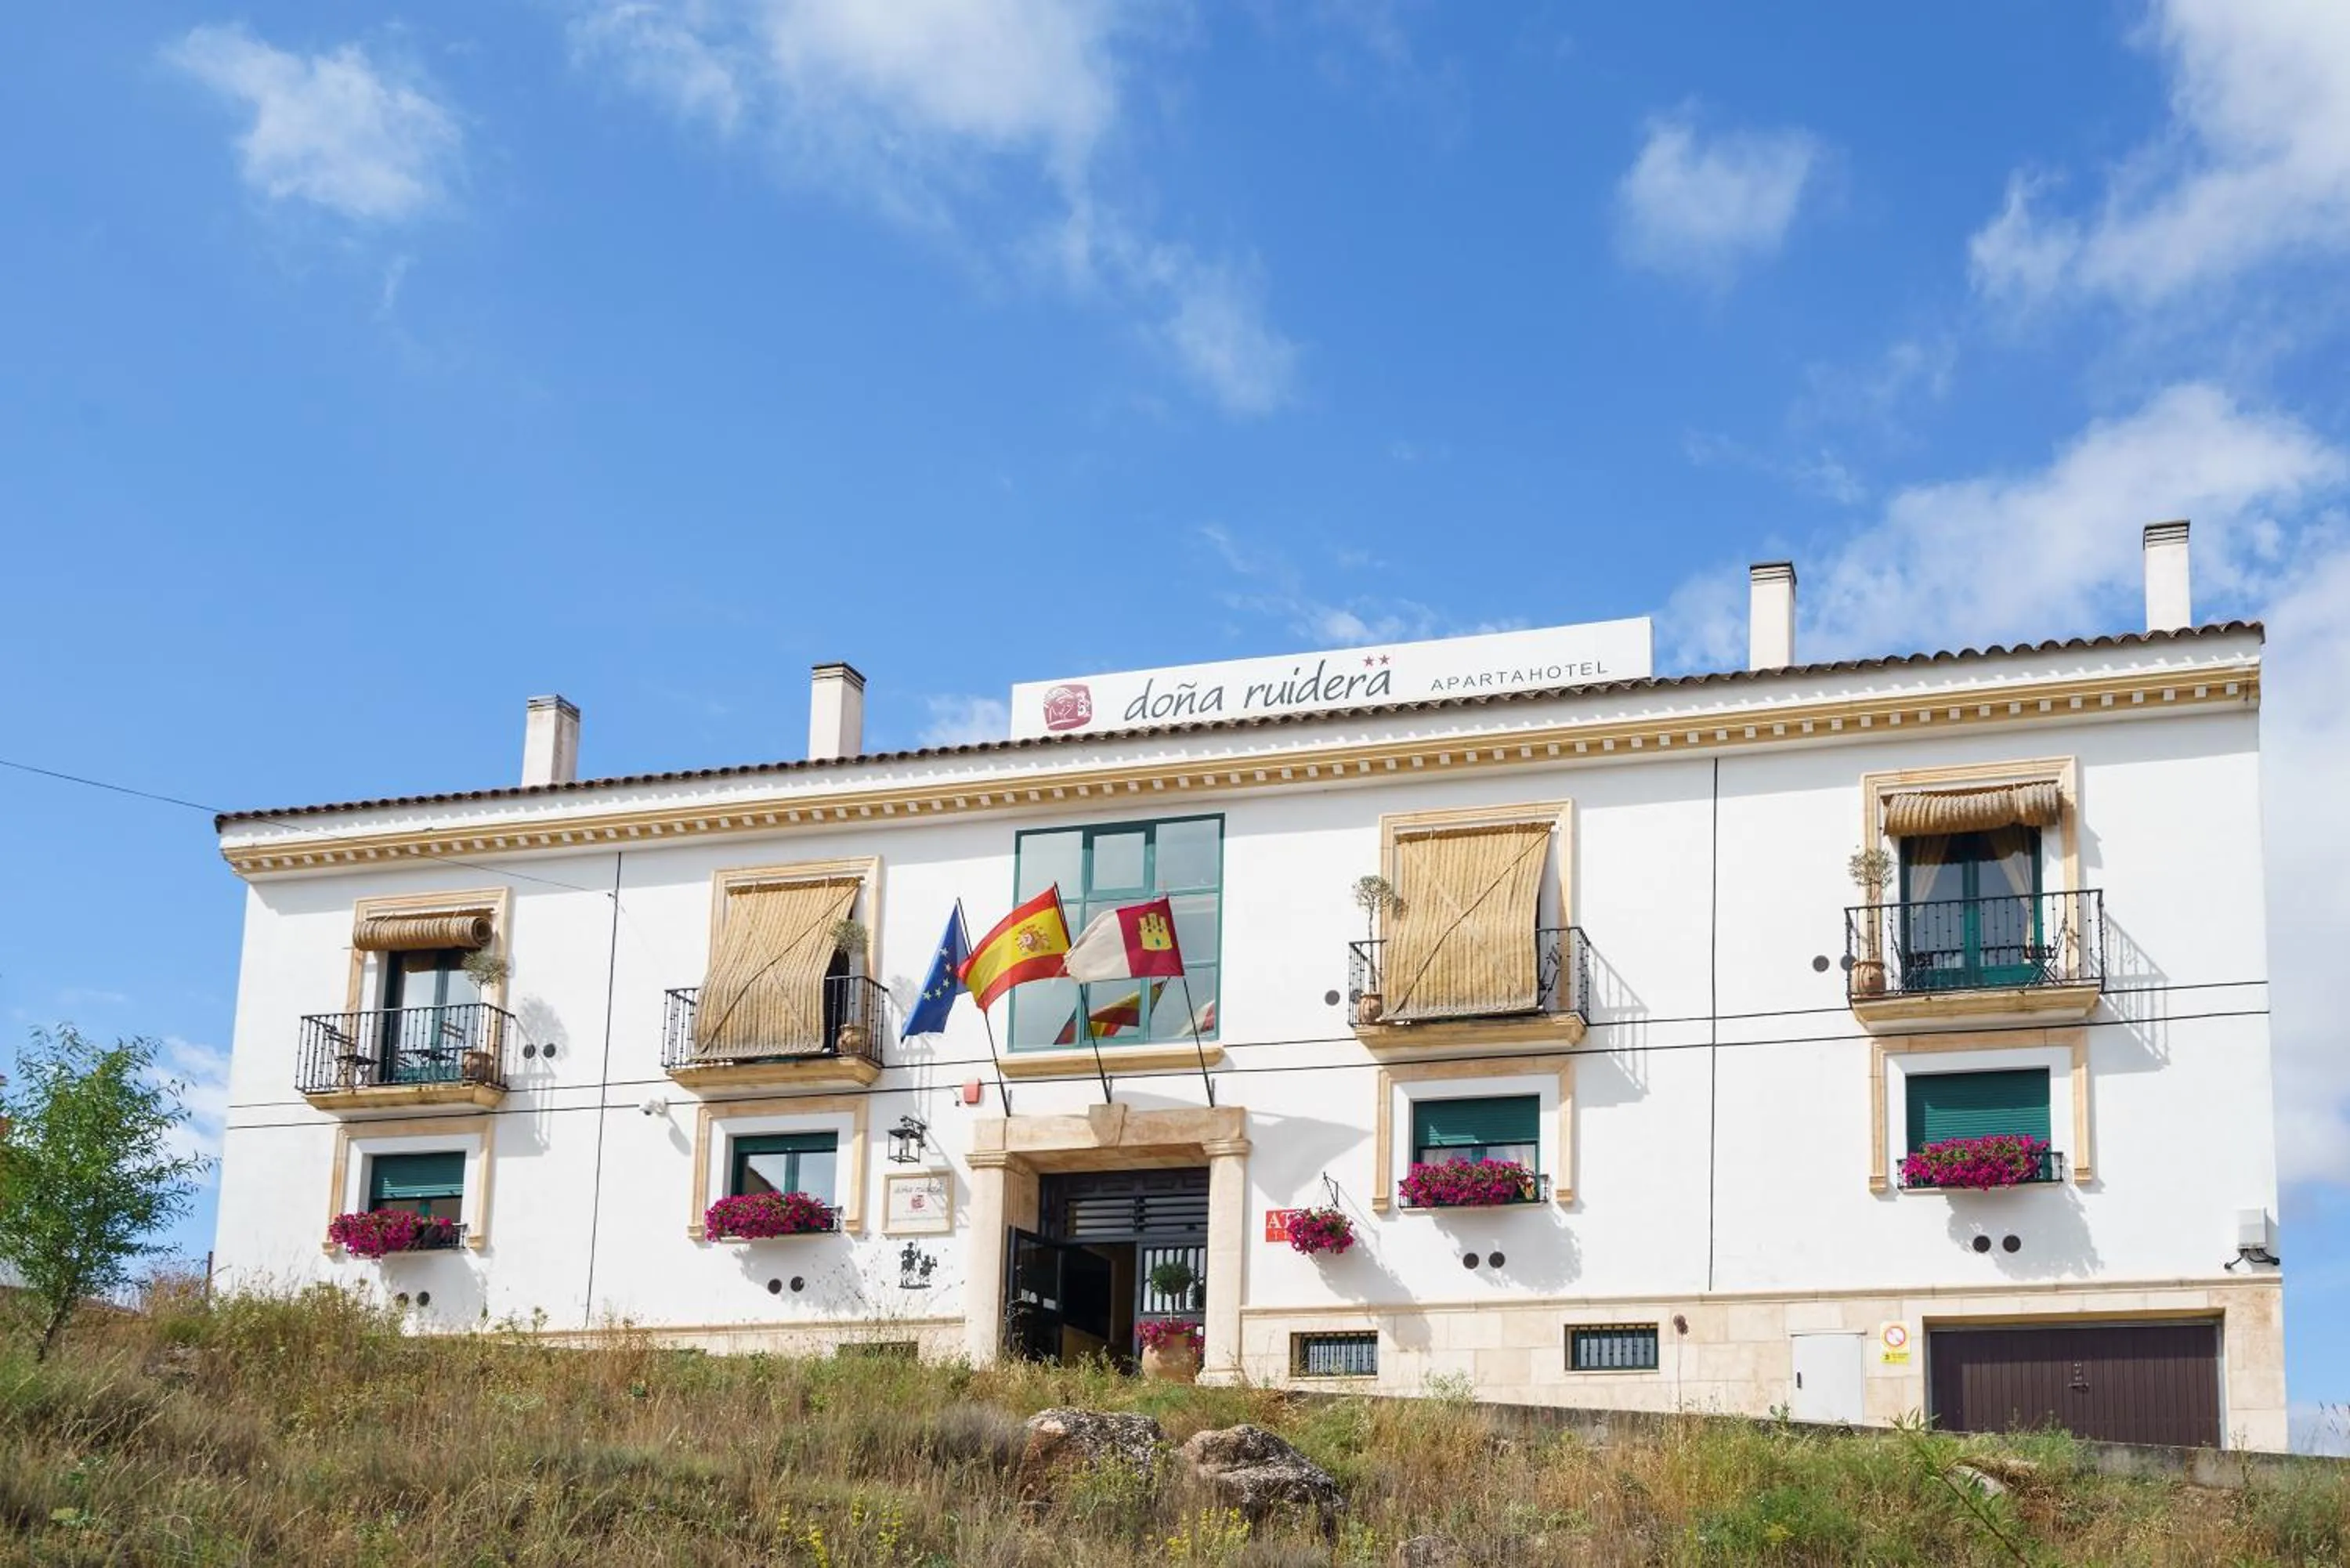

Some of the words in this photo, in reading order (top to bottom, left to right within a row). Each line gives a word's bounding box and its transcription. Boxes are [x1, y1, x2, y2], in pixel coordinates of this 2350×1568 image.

[1124, 678, 1224, 721] doña
[1243, 659, 1391, 708] ruidera
[1430, 660, 1609, 691] APARTAHOTEL
